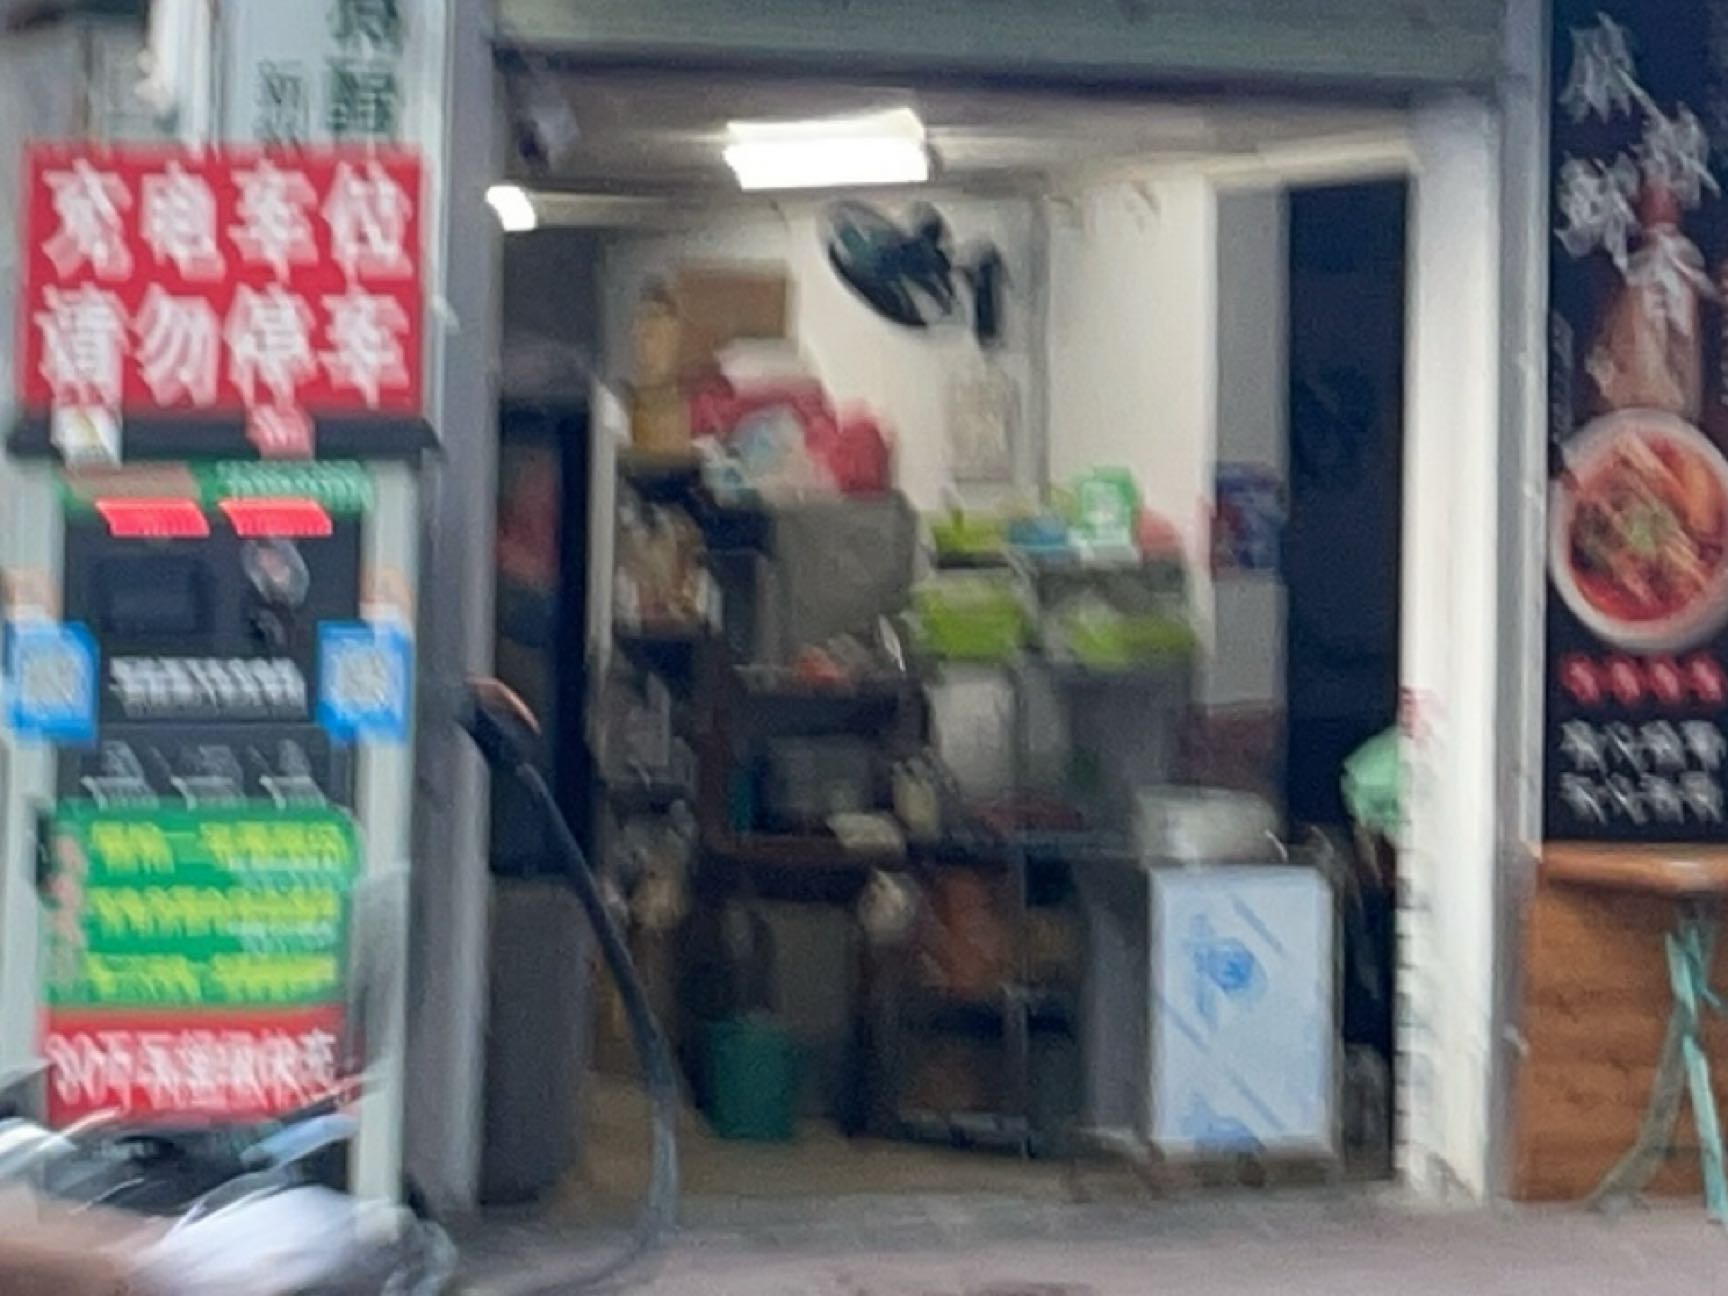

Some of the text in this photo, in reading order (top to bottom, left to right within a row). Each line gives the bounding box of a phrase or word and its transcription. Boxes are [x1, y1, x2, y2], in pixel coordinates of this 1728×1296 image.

[40, 156, 414, 282] 充电车位
[33, 281, 410, 410] 请勿停车
